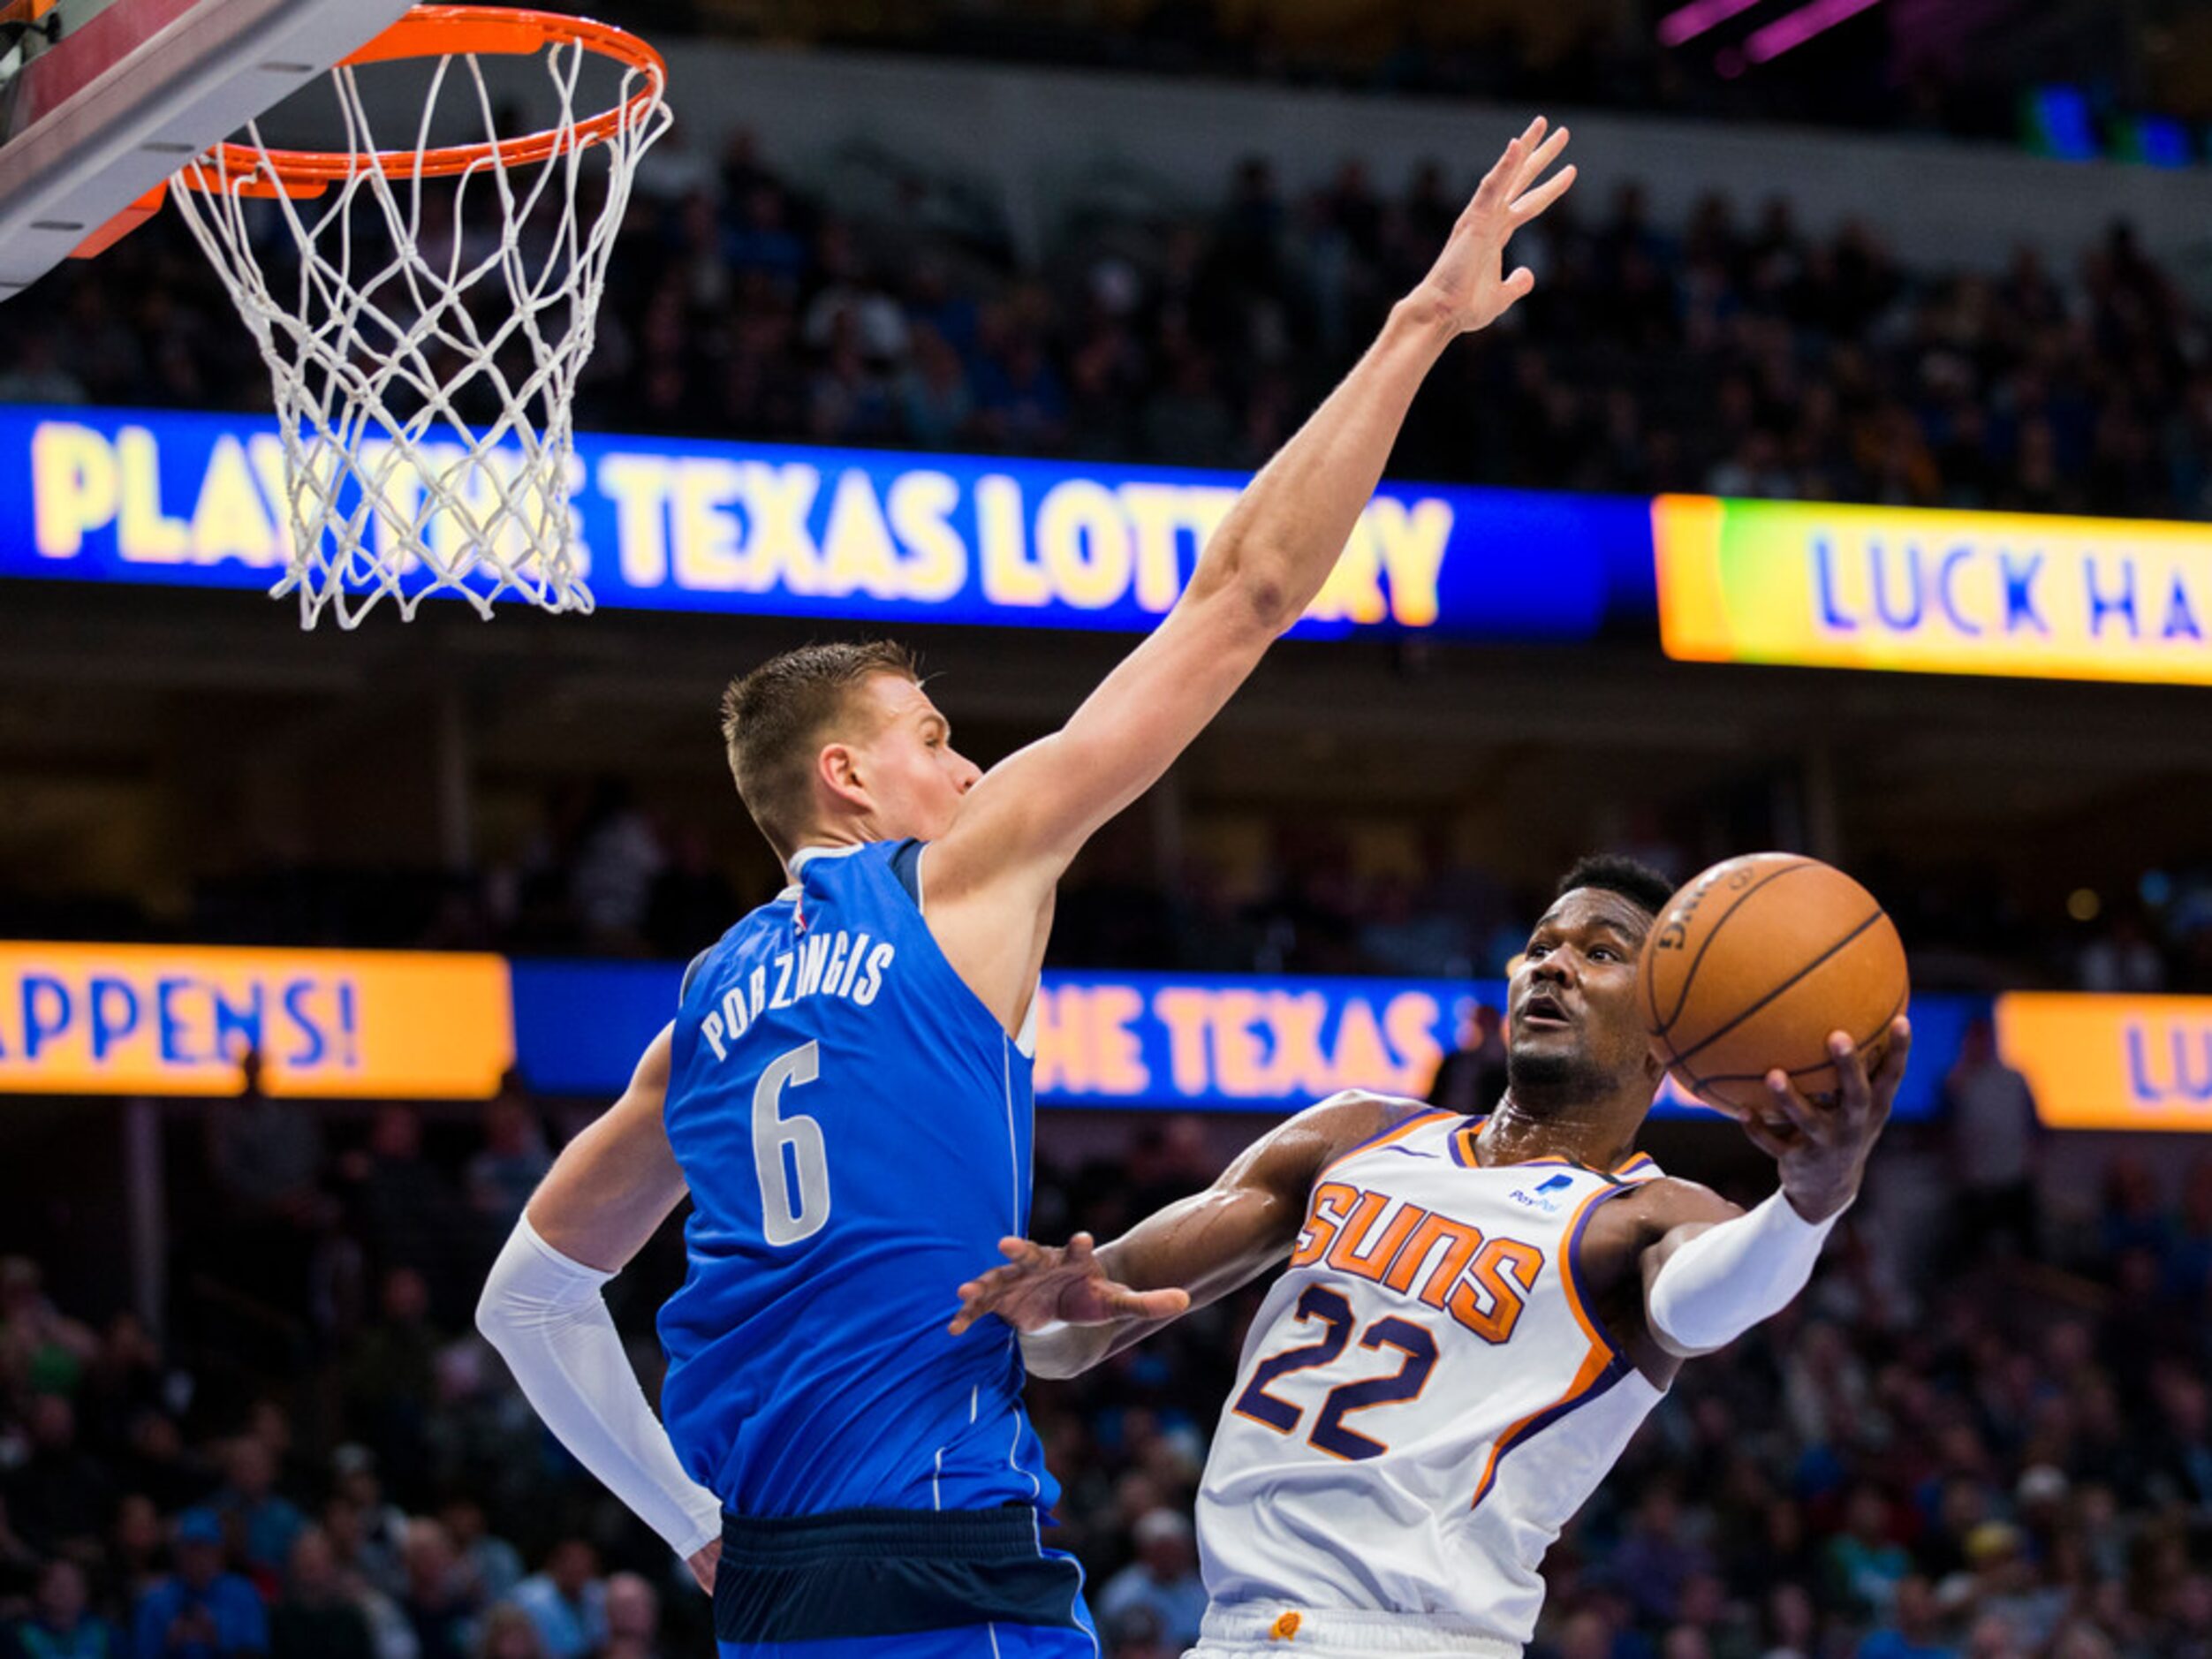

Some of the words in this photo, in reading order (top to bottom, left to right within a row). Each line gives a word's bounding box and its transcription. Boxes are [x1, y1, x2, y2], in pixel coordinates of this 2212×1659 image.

[31, 421, 341, 568] PLAY
[597, 451, 969, 603] TEXAS
[1814, 539, 2050, 638] LUCK
[2082, 557, 2201, 640] HA
[0, 977, 356, 1067] PPENS!
[701, 930, 895, 1062] PORZINGIS
[1033, 984, 1150, 1095] HE
[1152, 986, 1445, 1098] TEXAS
[752, 1038, 830, 1247] 6
[1509, 1190, 1562, 1214] PayPal
[1289, 1180, 1546, 1345] SUNS
[1231, 1282, 1440, 1462] 22
